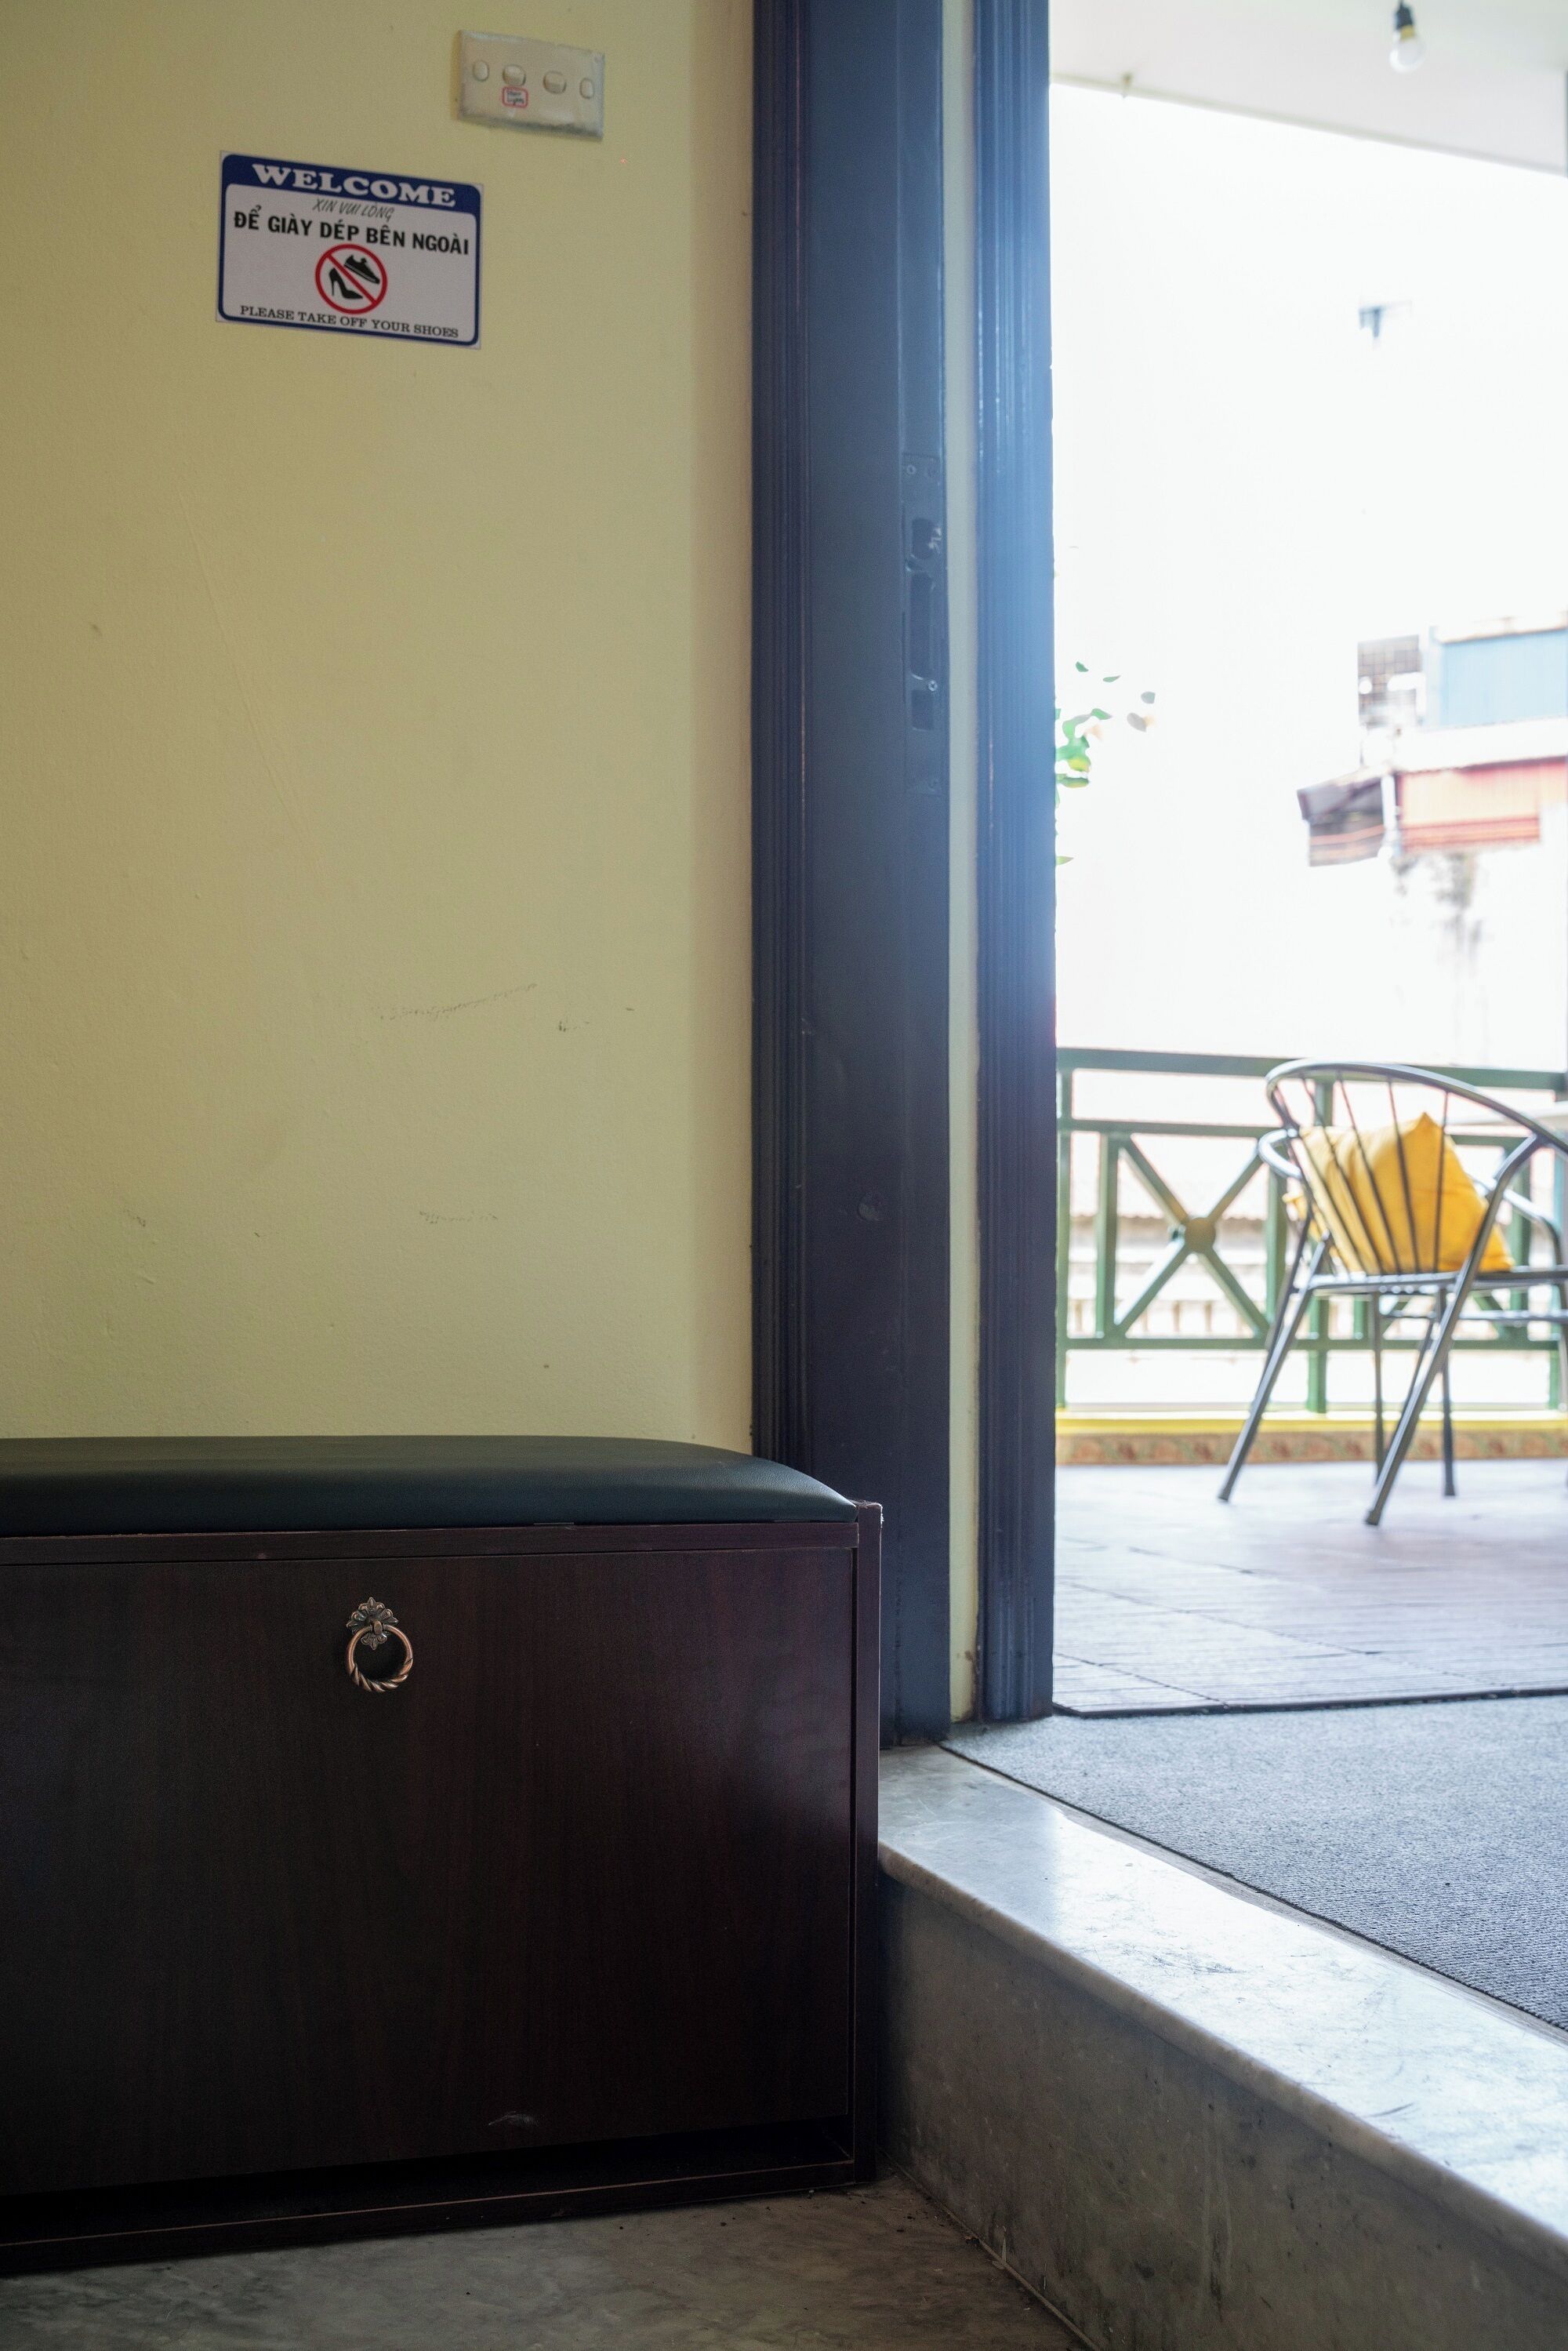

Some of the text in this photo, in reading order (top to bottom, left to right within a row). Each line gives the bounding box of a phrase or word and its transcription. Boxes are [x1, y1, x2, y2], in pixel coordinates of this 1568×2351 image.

[252, 163, 456, 208] WELCOME
[313, 198, 395, 222] XIN VUI LÒNG
[234, 205, 469, 256] ĐỂ GIÀY DÉP BÊN NGOÀI
[240, 305, 459, 338] PLEASE TAKE OFF YOUR SHOES
